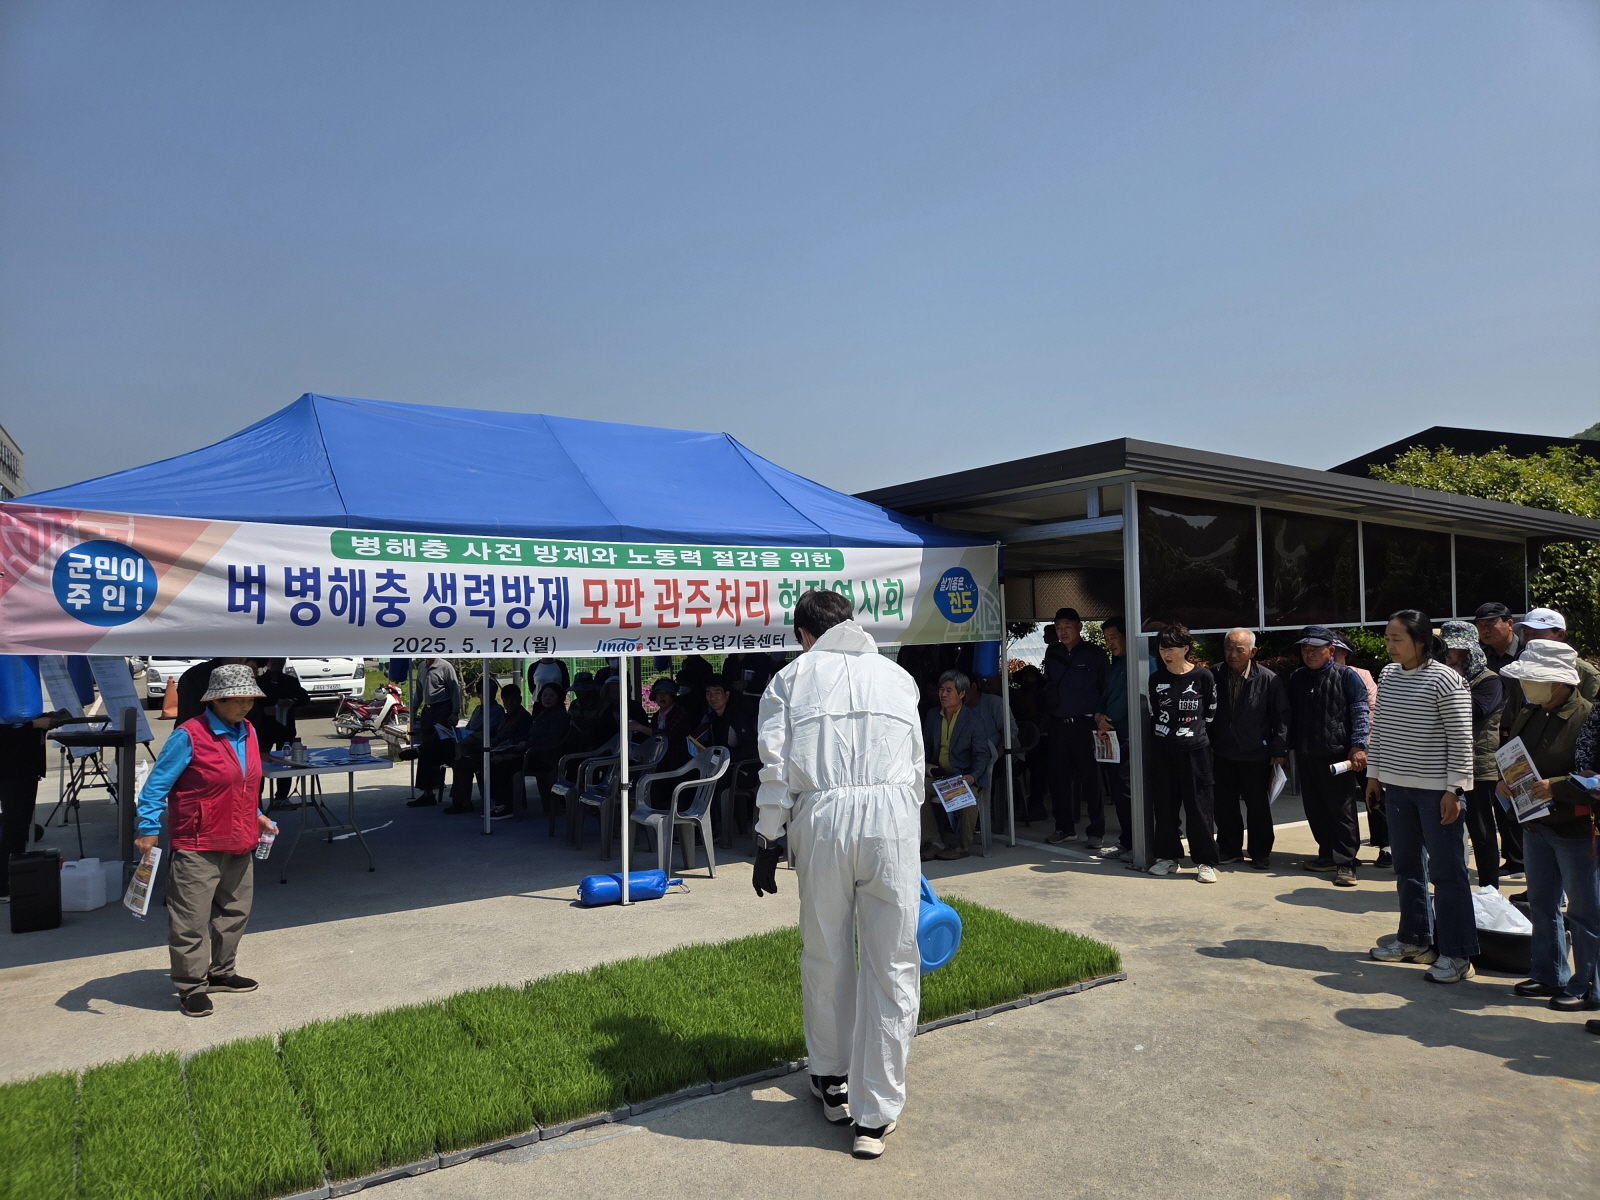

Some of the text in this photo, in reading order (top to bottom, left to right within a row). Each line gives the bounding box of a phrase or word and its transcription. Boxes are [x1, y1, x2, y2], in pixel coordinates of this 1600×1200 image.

[351, 536, 832, 568] 병해충 사전 방제와 노동력 절감을 위한
[67, 552, 144, 583] 군민이
[940, 576, 965, 592] 살기좋은
[227, 564, 904, 630] 벼 병해충 생력방제 모판 관주처리 현시회
[947, 591, 974, 614] 진도
[392, 637, 453, 653] 2025.
[461, 637, 481, 654] 5.
[592, 638, 636, 654] Jindo
[646, 633, 786, 652] 진도군농업기술센터
[1179, 700, 1198, 710] 1985
